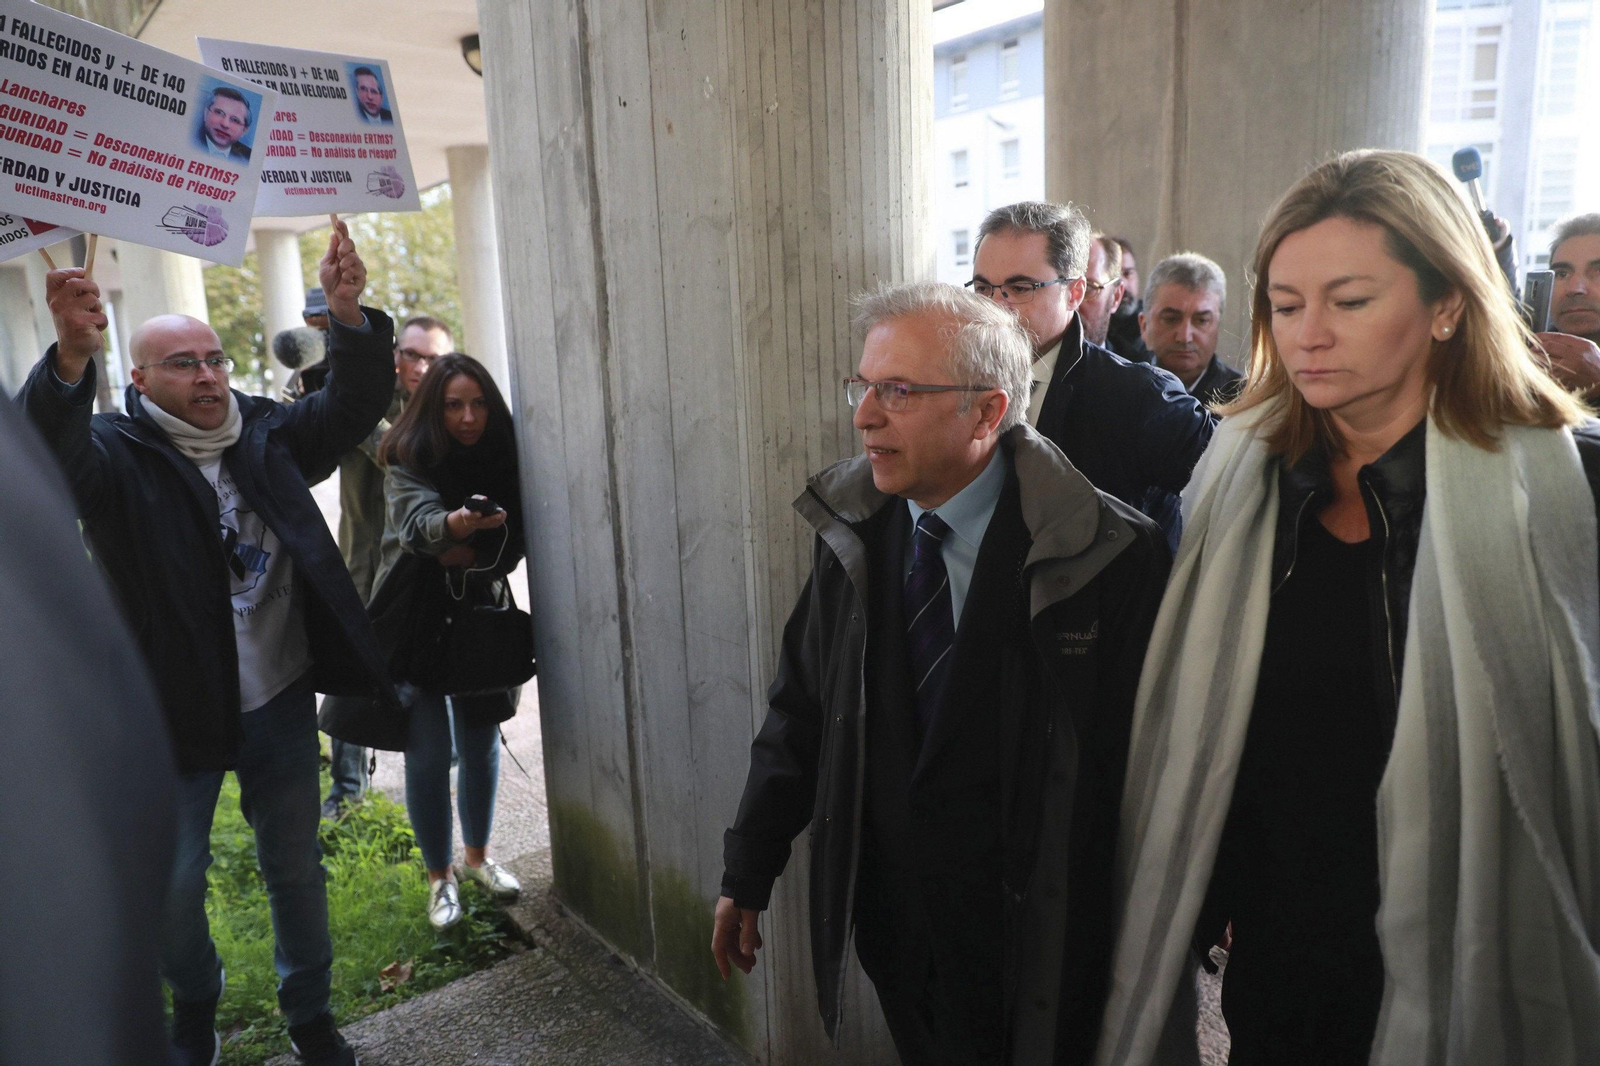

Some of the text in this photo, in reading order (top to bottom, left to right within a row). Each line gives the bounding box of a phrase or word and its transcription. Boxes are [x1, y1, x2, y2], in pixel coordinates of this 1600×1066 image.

[11, 18, 101, 65] FALLECIDOS
[121, 61, 134, 75] +
[141, 65, 158, 86] DE
[162, 73, 186, 93] 140
[221, 57, 233, 72] 81
[234, 58, 289, 78] FALLECIDOS
[311, 67, 323, 82] DE
[324, 68, 340, 82] 140
[0, 79, 87, 117] Lanchares
[52, 57, 72, 79] EN
[75, 66, 109, 91] ALTA
[113, 78, 187, 116] VELOCIDAD
[280, 81, 301, 96] ALTA
[301, 83, 348, 100] VELOCIDAD
[274, 110, 297, 123] ares
[309, 130, 362, 144] Desconexión
[364, 133, 394, 145] ERTMS?
[311, 146, 322, 158] No
[324, 146, 356, 159] análisis
[358, 148, 367, 158] de
[369, 148, 397, 160] riesgo?
[93, 132, 184, 170] Desconexión
[187, 160, 240, 187] ERTMS?
[55, 171, 66, 187] Y
[69, 176, 141, 208] JUSTICIA
[87, 149, 106, 167] No
[109, 155, 165, 184] análisis
[167, 170, 184, 189] de
[186, 177, 237, 203] riesgo?
[300, 170, 307, 183] Y
[310, 170, 352, 183] JUSTICIA
[15, 182, 107, 214] victimastren.org
